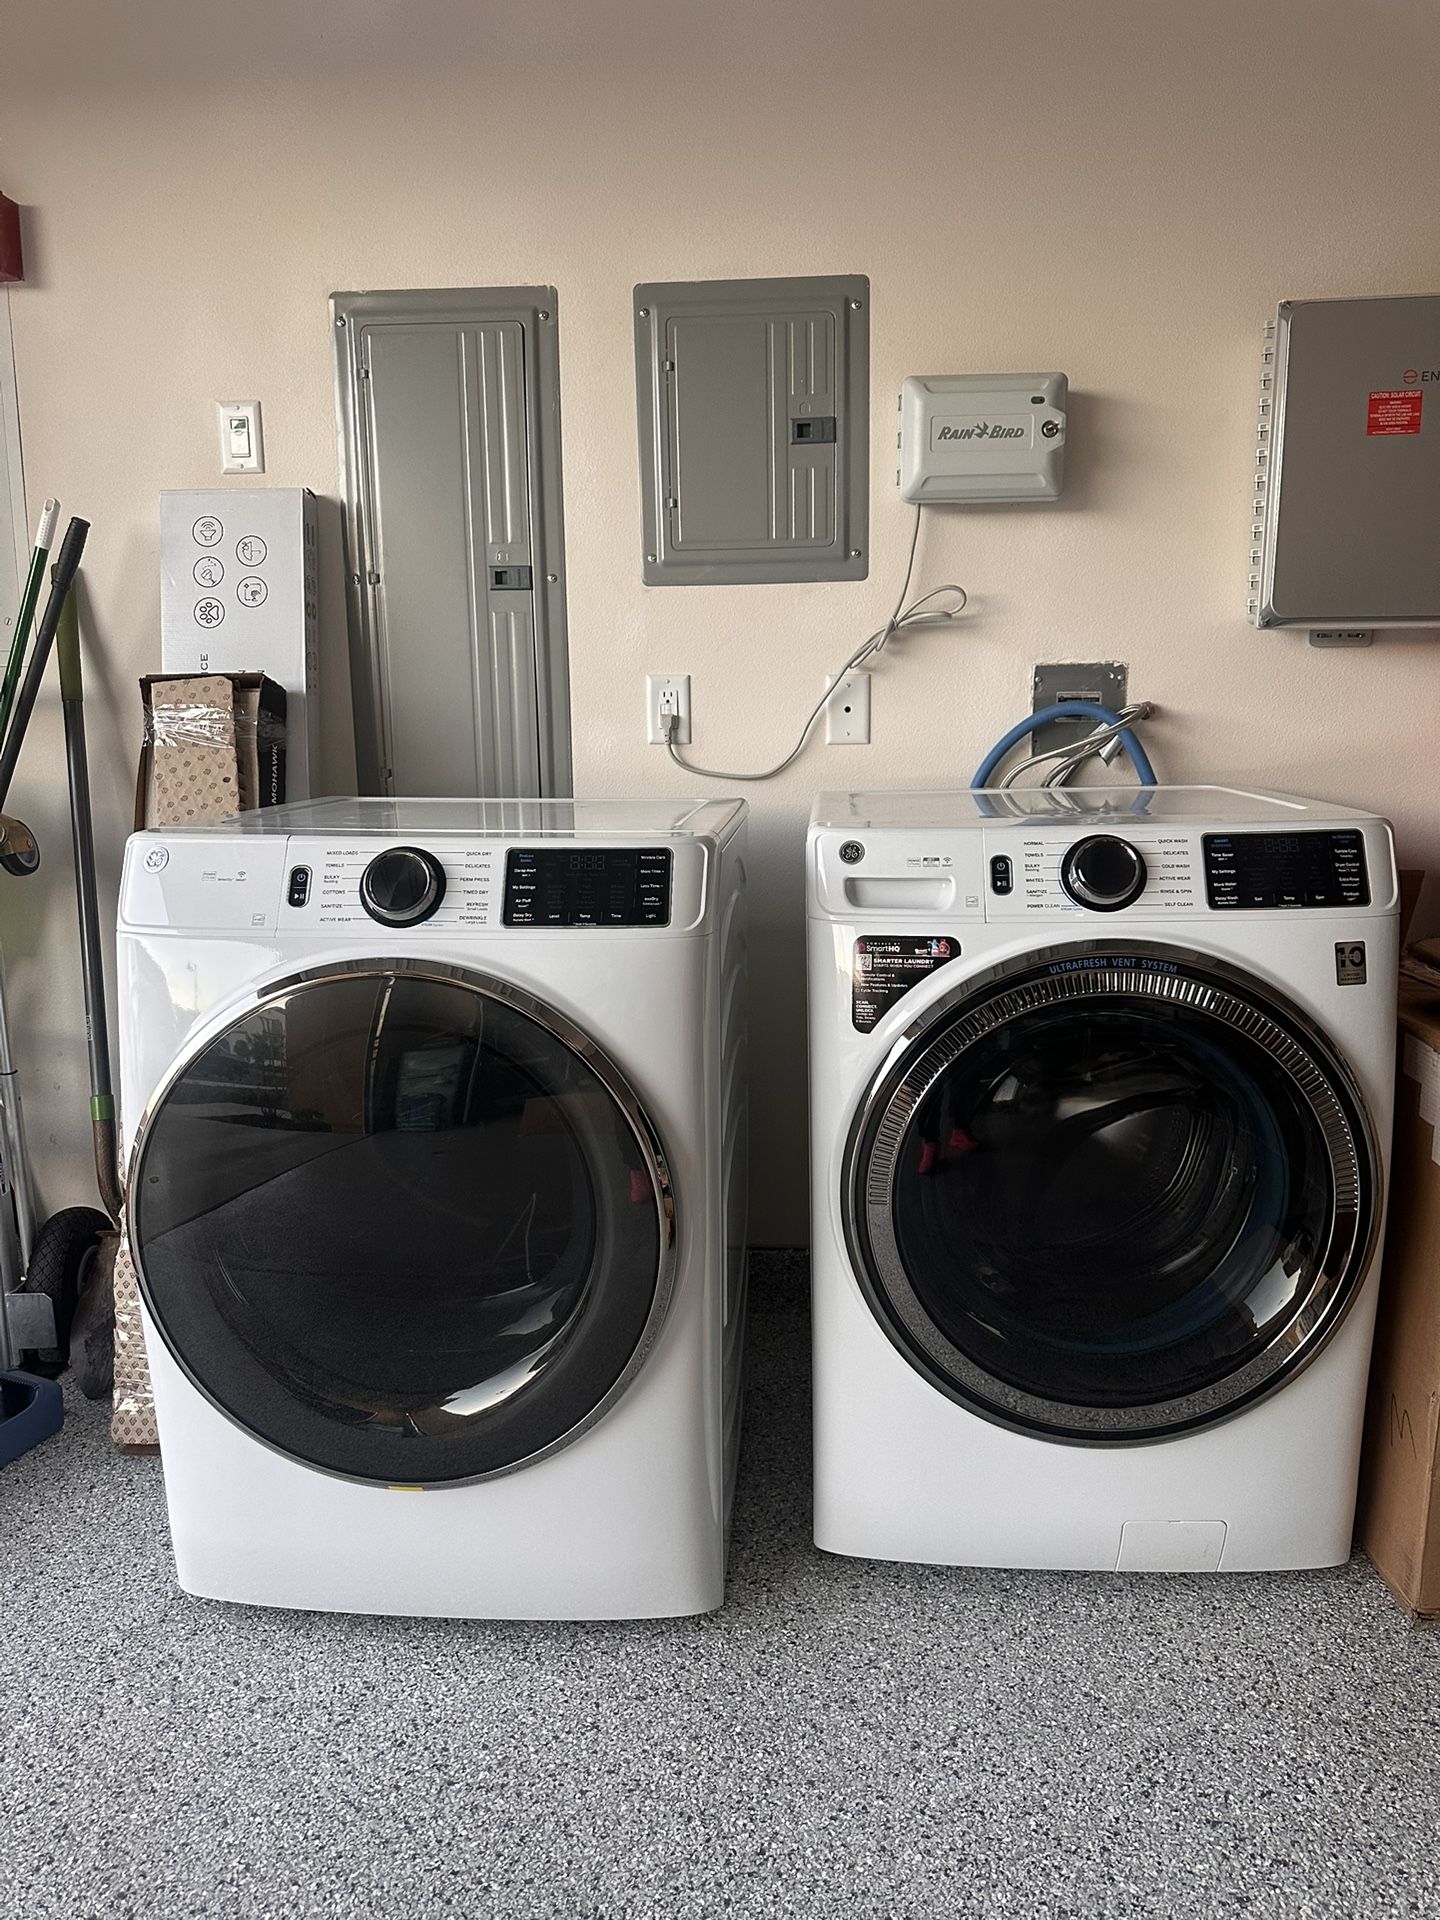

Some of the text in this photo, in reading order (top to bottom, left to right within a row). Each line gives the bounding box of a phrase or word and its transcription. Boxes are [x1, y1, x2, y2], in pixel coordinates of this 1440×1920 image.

[937, 424, 1025, 440] RAIN BIRD
[200, 653, 208, 674] CE
[270, 744, 279, 804] MOHAWK
[866, 945, 900, 953] SmartHQ
[1336, 946, 1365, 968] 10
[1049, 958, 1178, 974] ULTRAFRESH VENT SYSTEM
[1390, 1392, 1418, 1461] M
